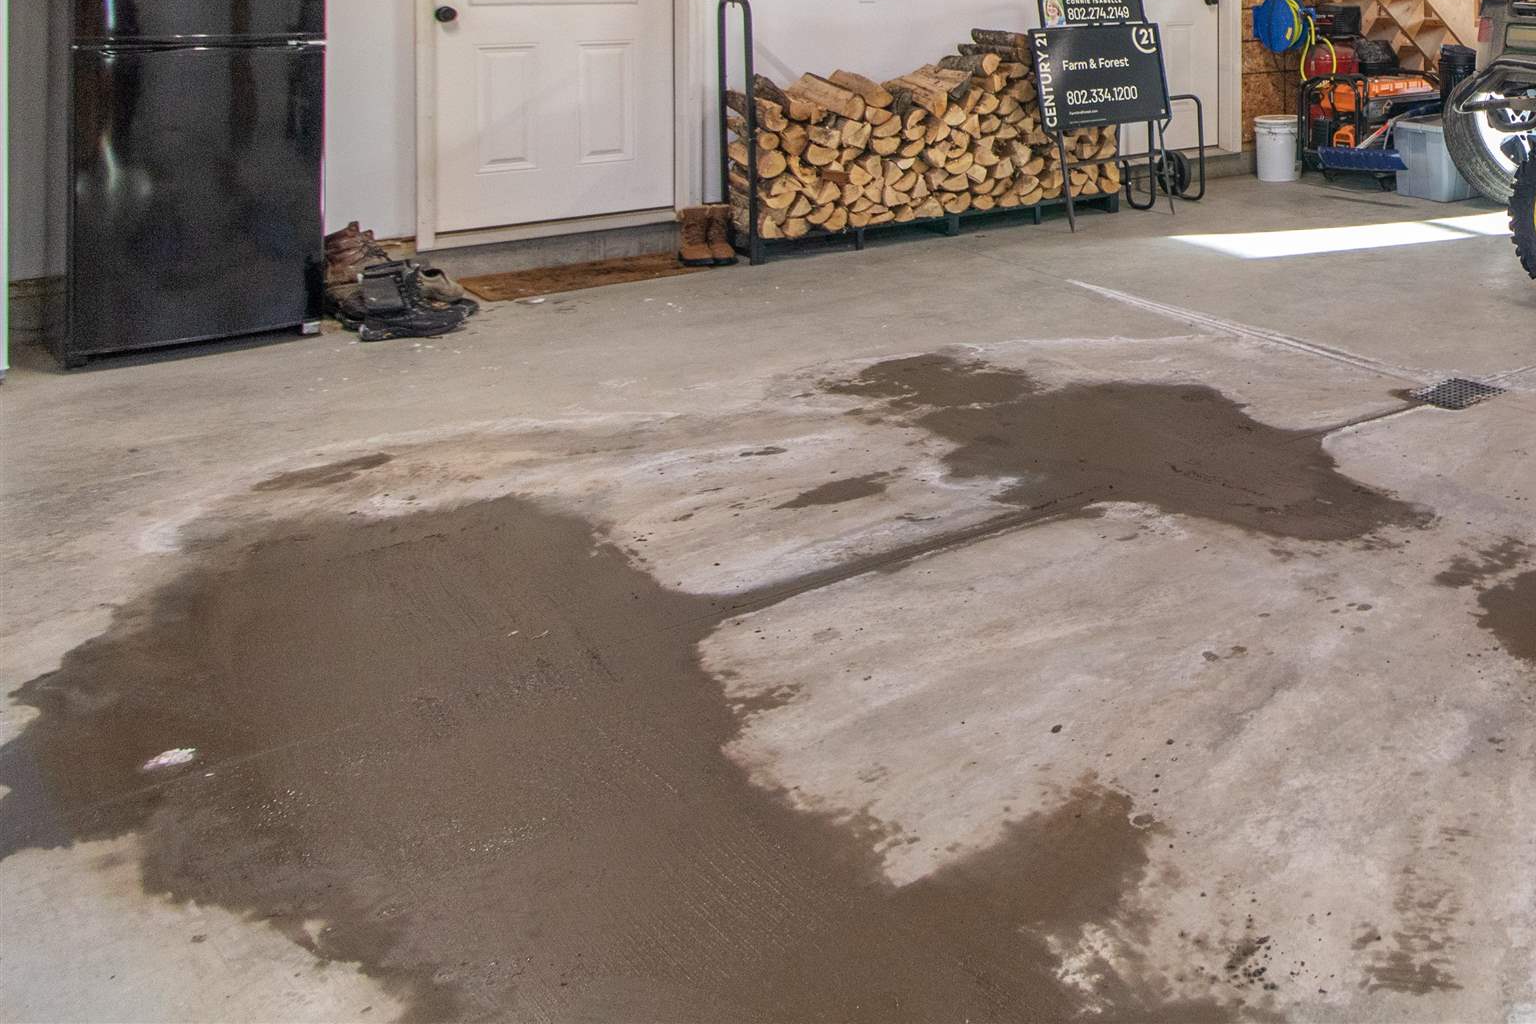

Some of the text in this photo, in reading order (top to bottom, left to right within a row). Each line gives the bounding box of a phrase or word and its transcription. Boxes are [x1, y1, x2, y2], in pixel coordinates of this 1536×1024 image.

[1067, 6, 1130, 20] 802.274.2149
[1062, 57, 1130, 72] Farm & Forest
[1034, 33, 1058, 128] CENTURY 21
[1066, 85, 1139, 106] 802.334.1200
